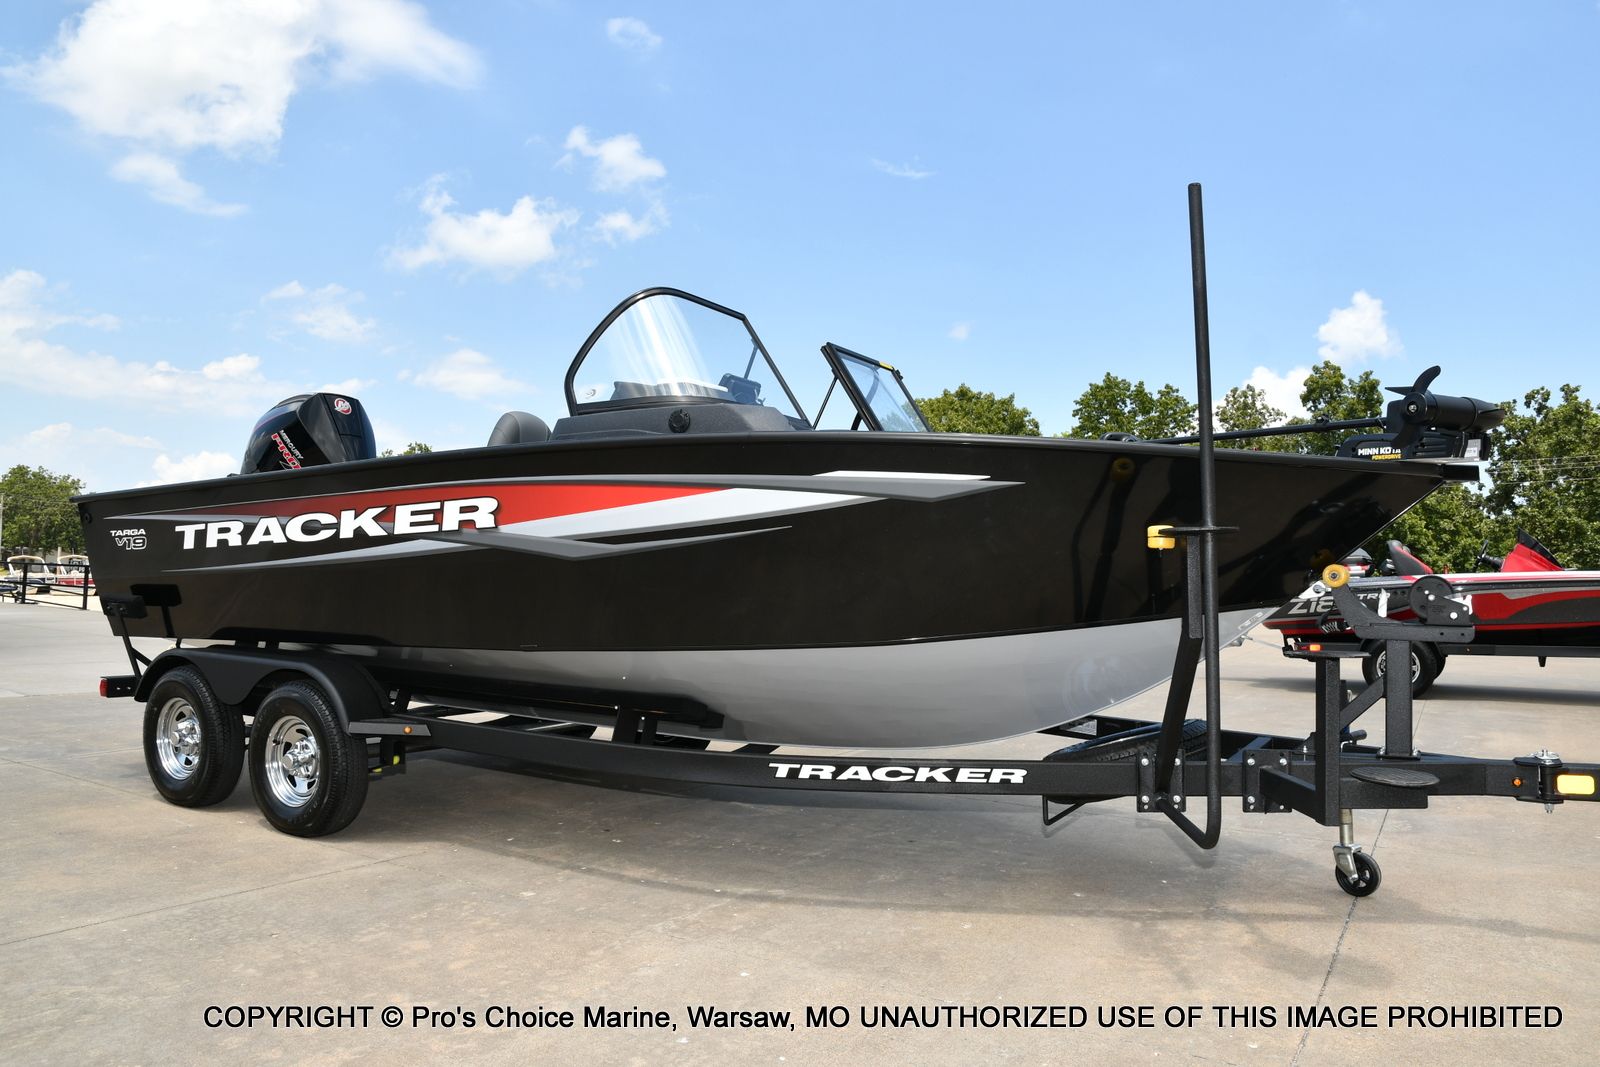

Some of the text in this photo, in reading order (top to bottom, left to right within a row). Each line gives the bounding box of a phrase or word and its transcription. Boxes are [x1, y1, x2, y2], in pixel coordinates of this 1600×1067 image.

[280, 430, 303, 459] MERCURY
[1357, 448, 1379, 456] MINN
[109, 528, 147, 537] TARGA
[174, 496, 499, 551] TRACKER
[115, 536, 147, 550] V19
[768, 762, 1028, 784] TRACKER
